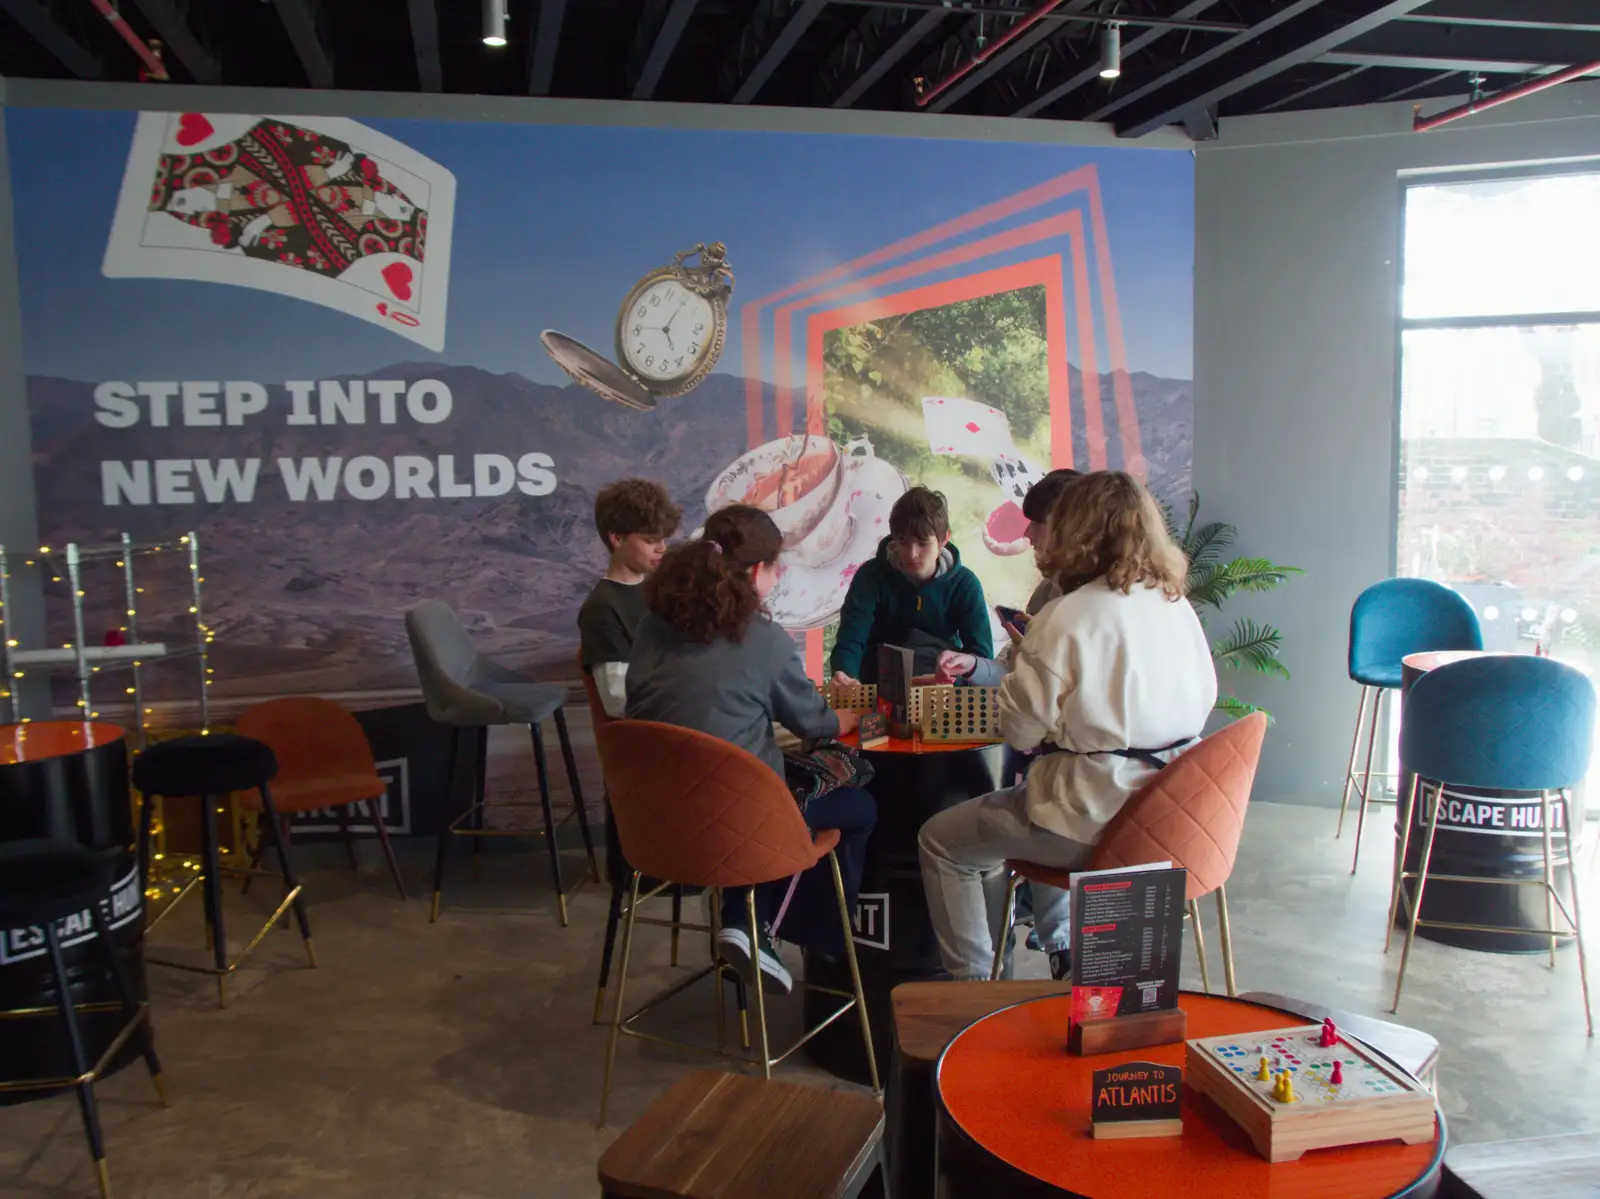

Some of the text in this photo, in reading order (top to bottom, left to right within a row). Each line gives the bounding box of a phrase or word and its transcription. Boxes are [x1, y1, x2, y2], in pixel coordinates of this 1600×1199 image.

[94, 378, 453, 428] STEP INTO
[100, 451, 558, 506] NEW WORLDS
[1105, 1070, 1165, 1083] JOURNEY TO
[1097, 1083, 1177, 1108] ATLANTIS
